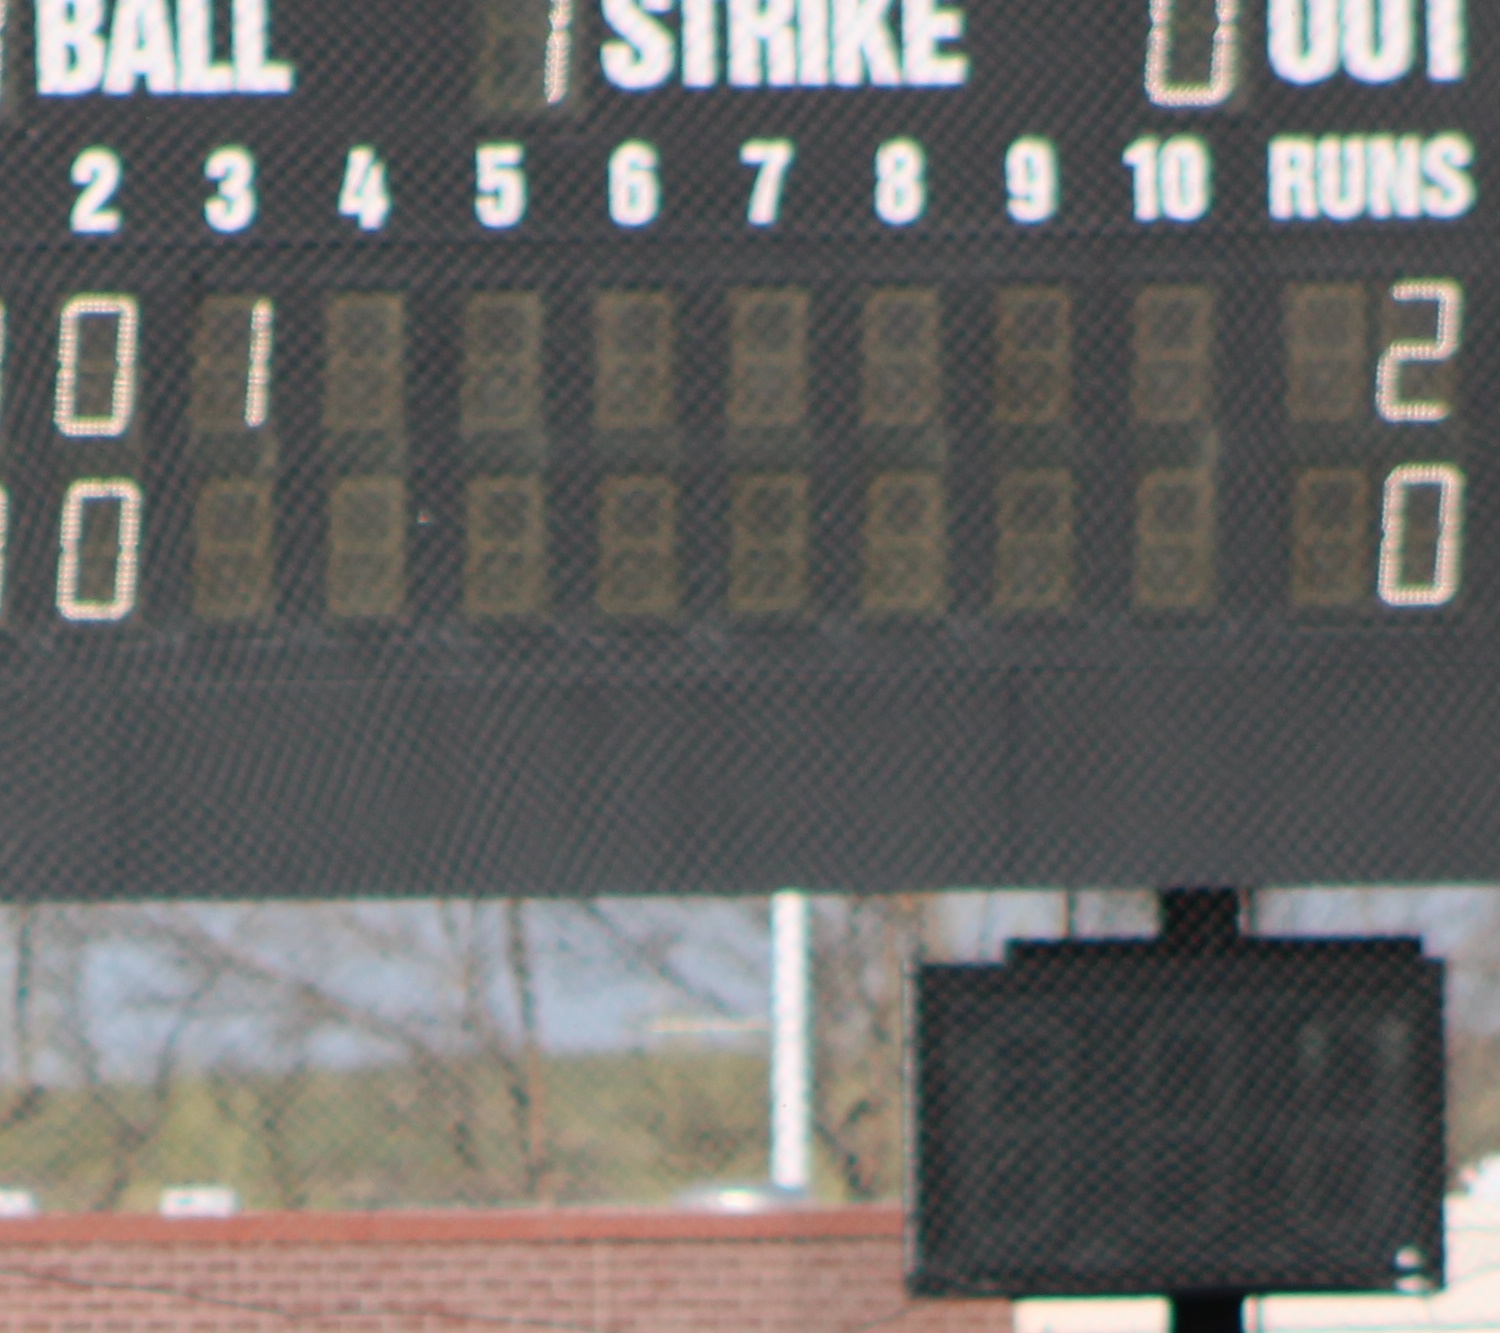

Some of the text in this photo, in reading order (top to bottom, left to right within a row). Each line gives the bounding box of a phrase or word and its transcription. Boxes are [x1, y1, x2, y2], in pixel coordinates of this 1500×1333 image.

[34, 0, 294, 97] BALL
[600, 0, 968, 91] STRIKE
[70, 148, 121, 234] 2
[204, 147, 256, 234] 3
[338, 146, 390, 231] 4
[474, 143, 526, 229] 5
[608, 141, 659, 227] 6
[740, 140, 793, 226] 7
[874, 138, 925, 226] 8
[1004, 137, 1057, 224] 9
[1122, 136, 1210, 222] 10
[1267, 133, 1474, 222] RUNS
[53, 295, 138, 438] 0
[244, 301, 273, 428] 1
[1374, 281, 1460, 423] 2
[55, 479, 142, 622] 0
[1377, 464, 1462, 607] 0
